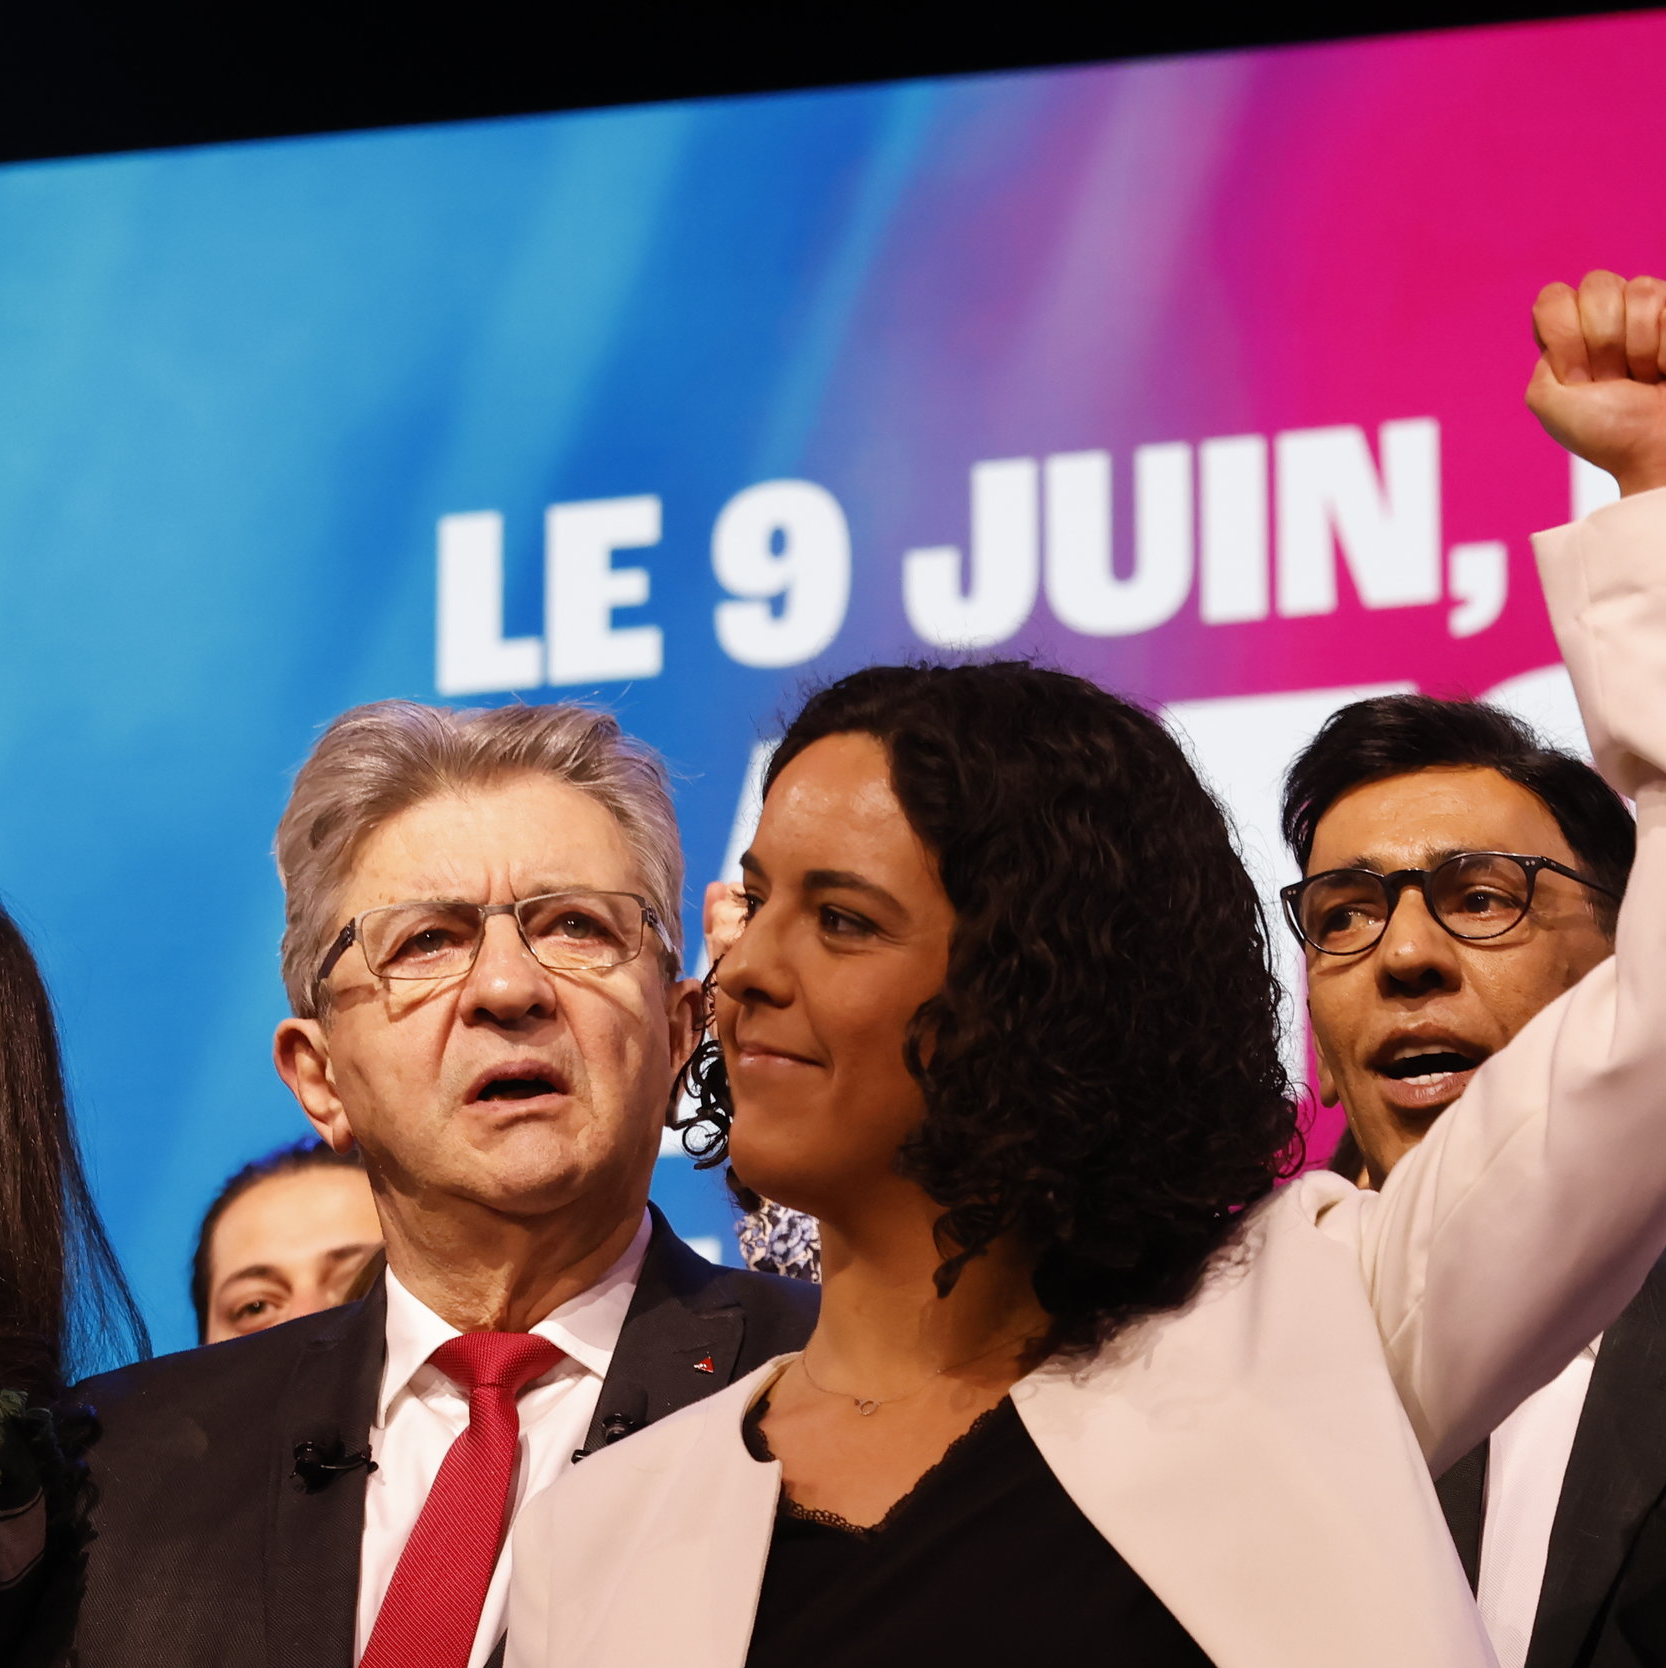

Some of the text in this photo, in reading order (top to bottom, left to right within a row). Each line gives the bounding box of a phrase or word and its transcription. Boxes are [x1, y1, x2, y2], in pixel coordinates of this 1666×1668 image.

[434, 494, 665, 697] LE
[711, 478, 854, 670] 9
[900, 416, 1509, 656] JUIN,
